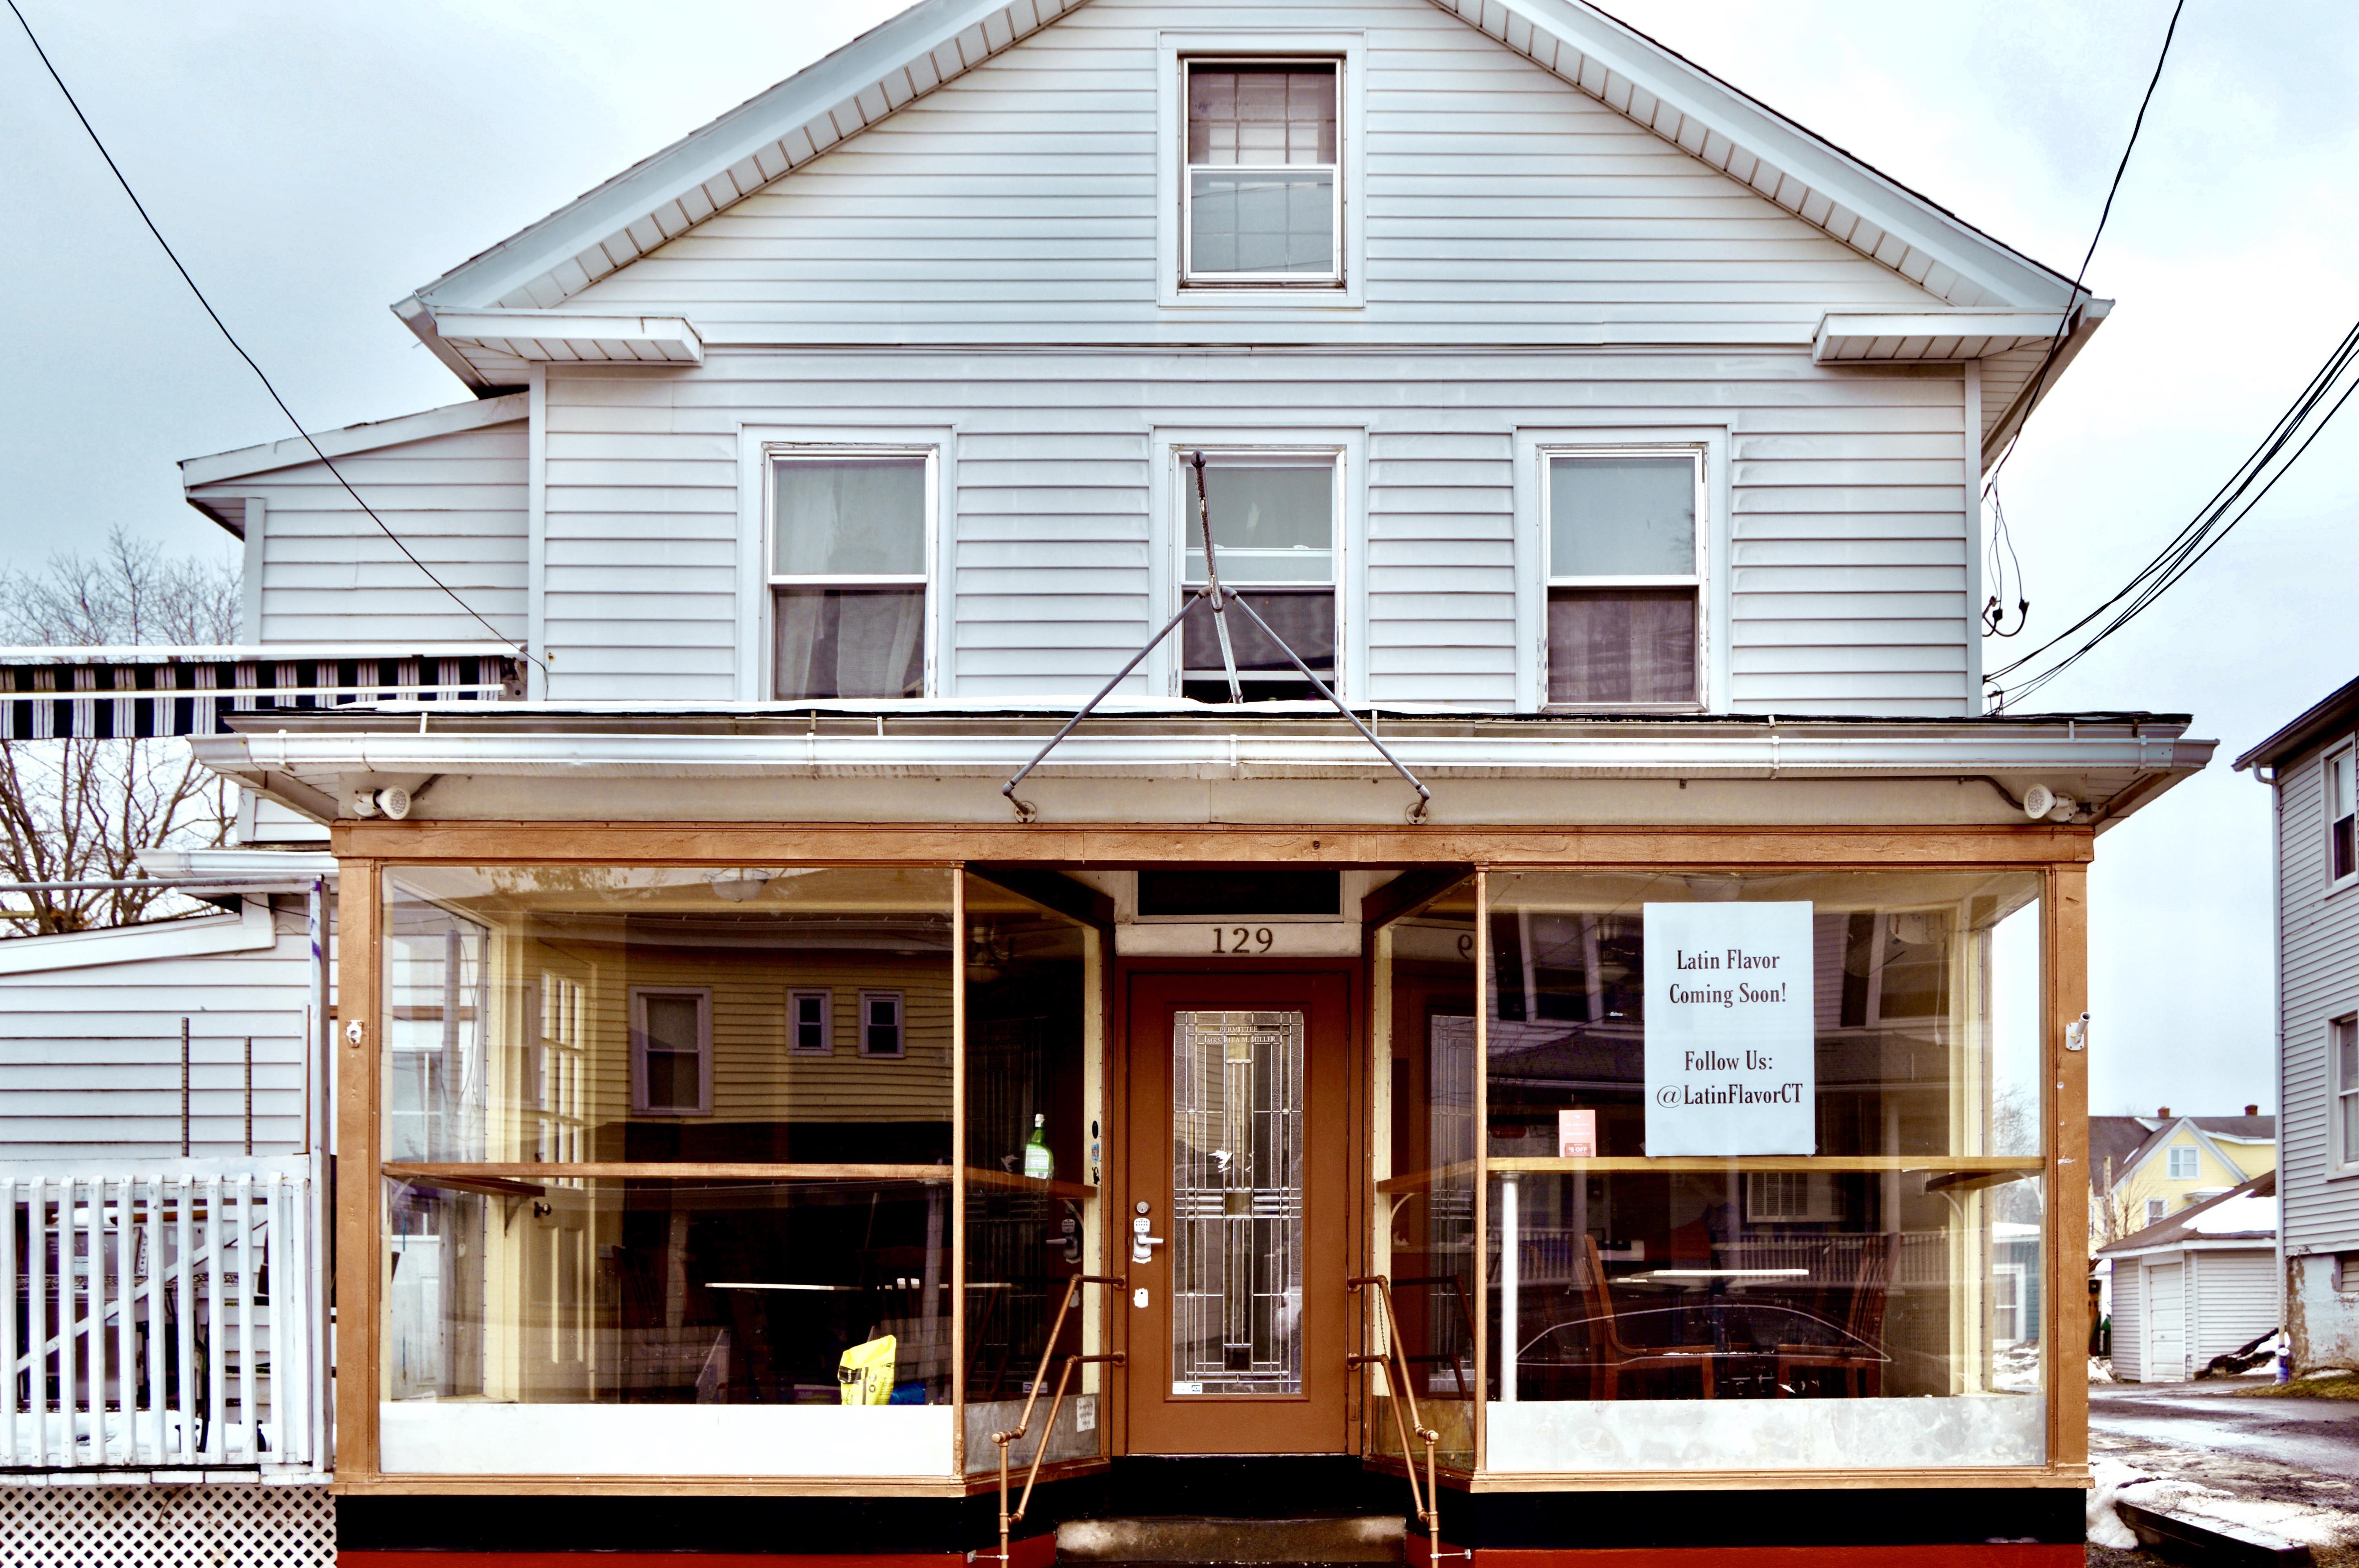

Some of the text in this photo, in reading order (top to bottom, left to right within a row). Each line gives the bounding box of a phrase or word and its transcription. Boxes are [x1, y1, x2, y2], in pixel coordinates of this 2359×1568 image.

[1212, 928, 1273, 954] 129
[1677, 949, 1780, 969] Latin Flavor
[1670, 982, 1786, 1008] Coming Soon!
[1685, 1050, 1772, 1071] Follow Us:
[1657, 1083, 1803, 1109] @LatinFlavorCT
